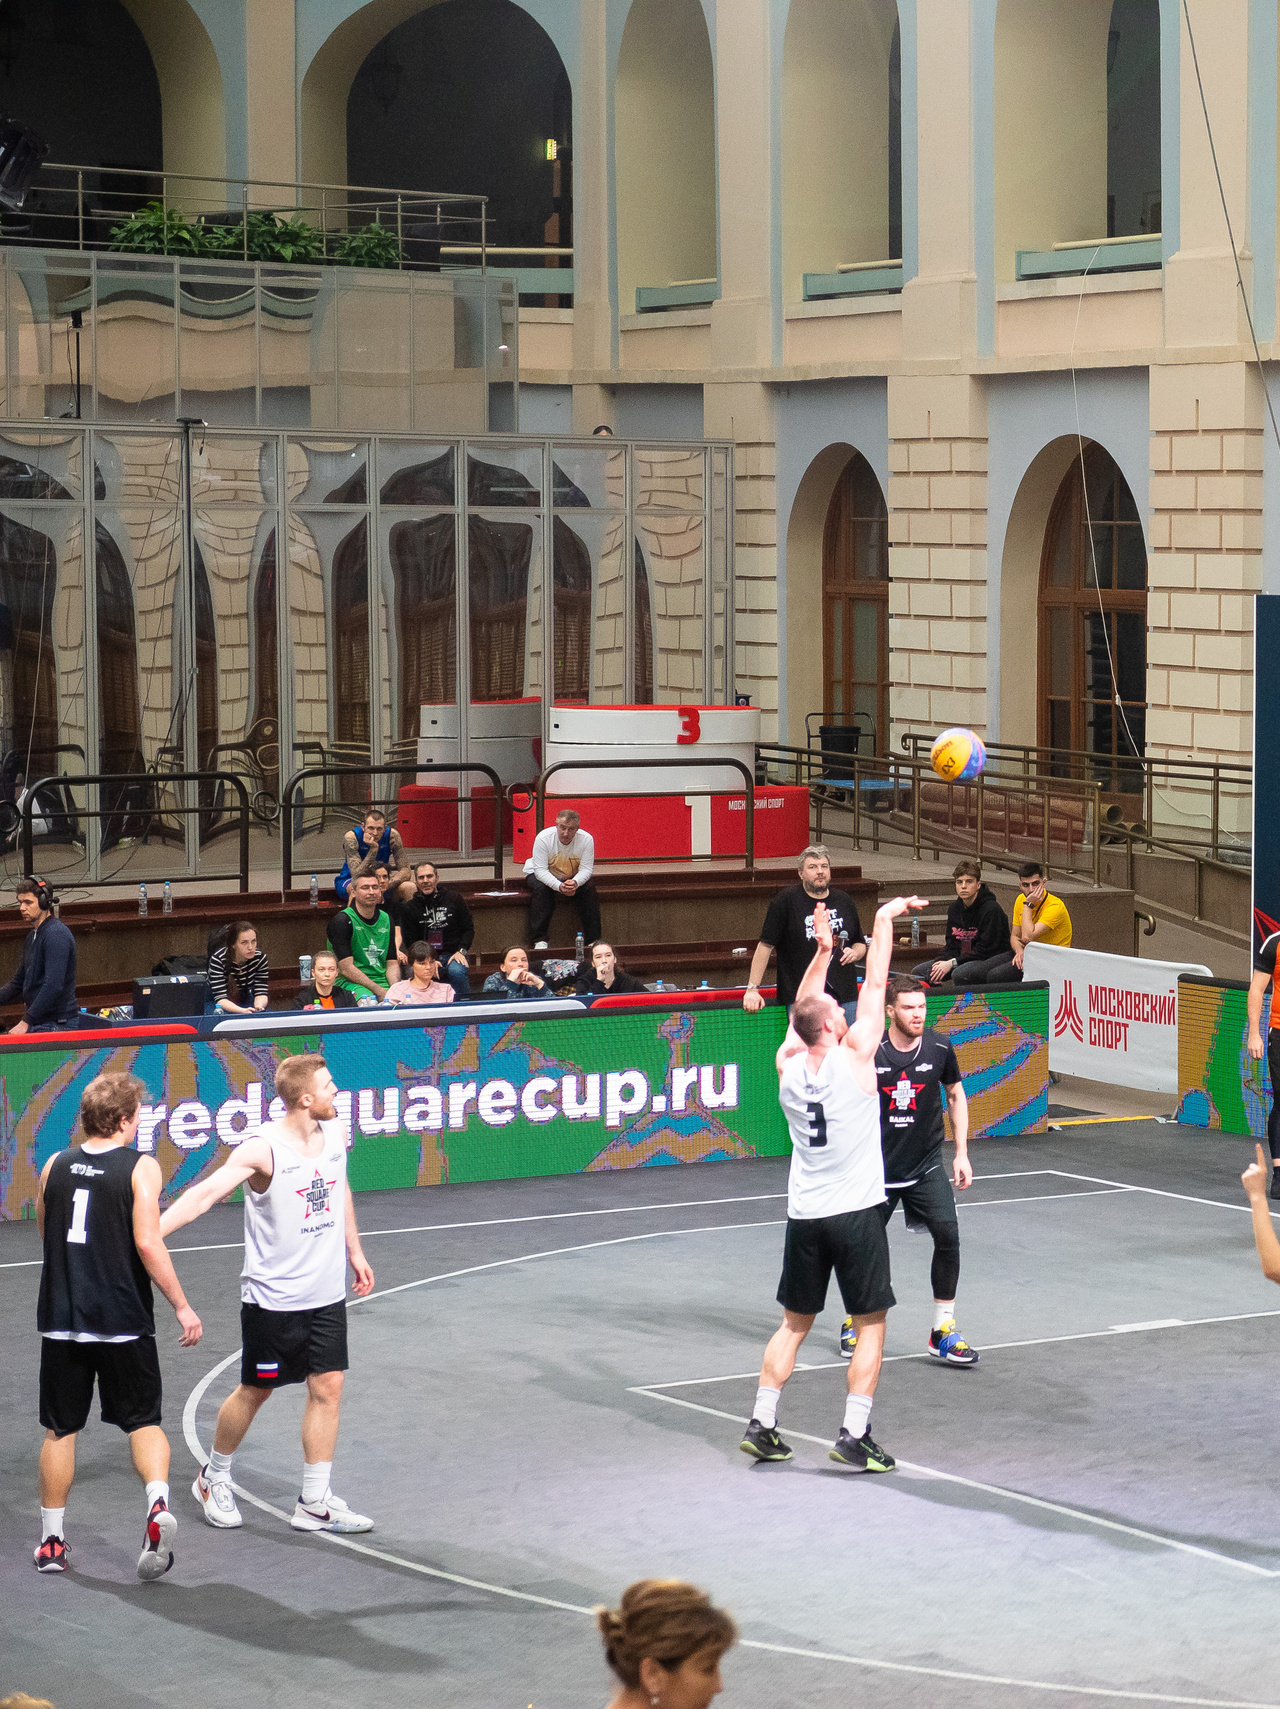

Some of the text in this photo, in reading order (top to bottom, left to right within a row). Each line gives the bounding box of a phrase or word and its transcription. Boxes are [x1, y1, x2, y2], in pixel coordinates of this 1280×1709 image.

[677, 707, 701, 744] 3
[728, 797, 785, 811] МОСКСКИЙ СПОРТ
[685, 785, 712, 862] 1
[1088, 984, 1176, 1026] МОСКОВСКИЙ
[1088, 1016, 1130, 1052] СПОРТ
[806, 1102, 828, 1148] 3
[306, 1187, 330, 1203] SQUARE
[311, 1178, 325, 1190] RED
[66, 1187, 90, 1244] 1
[311, 1200, 326, 1213] CUP
